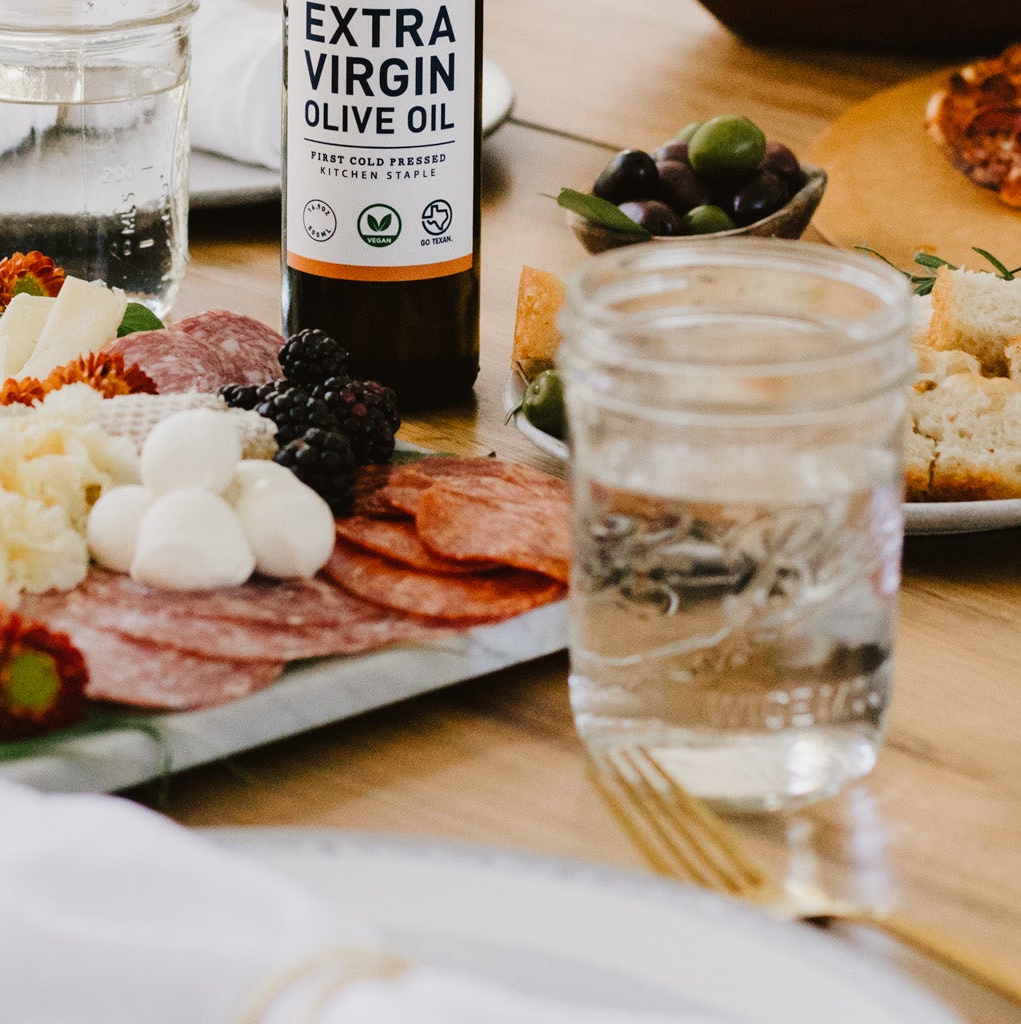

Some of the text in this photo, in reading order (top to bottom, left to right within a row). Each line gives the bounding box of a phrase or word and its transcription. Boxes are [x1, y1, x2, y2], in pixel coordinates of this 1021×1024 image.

[305, 1, 456, 47] EXTRA
[304, 49, 455, 97] VIRGIN
[304, 99, 455, 134] OLIVE OIL
[311, 151, 446, 167] FIRST COLD PRESSED
[320, 166, 436, 180] KITCHEN STAPLE
[367, 236, 392, 244] VEGAN
[420, 239, 430, 247] GO
